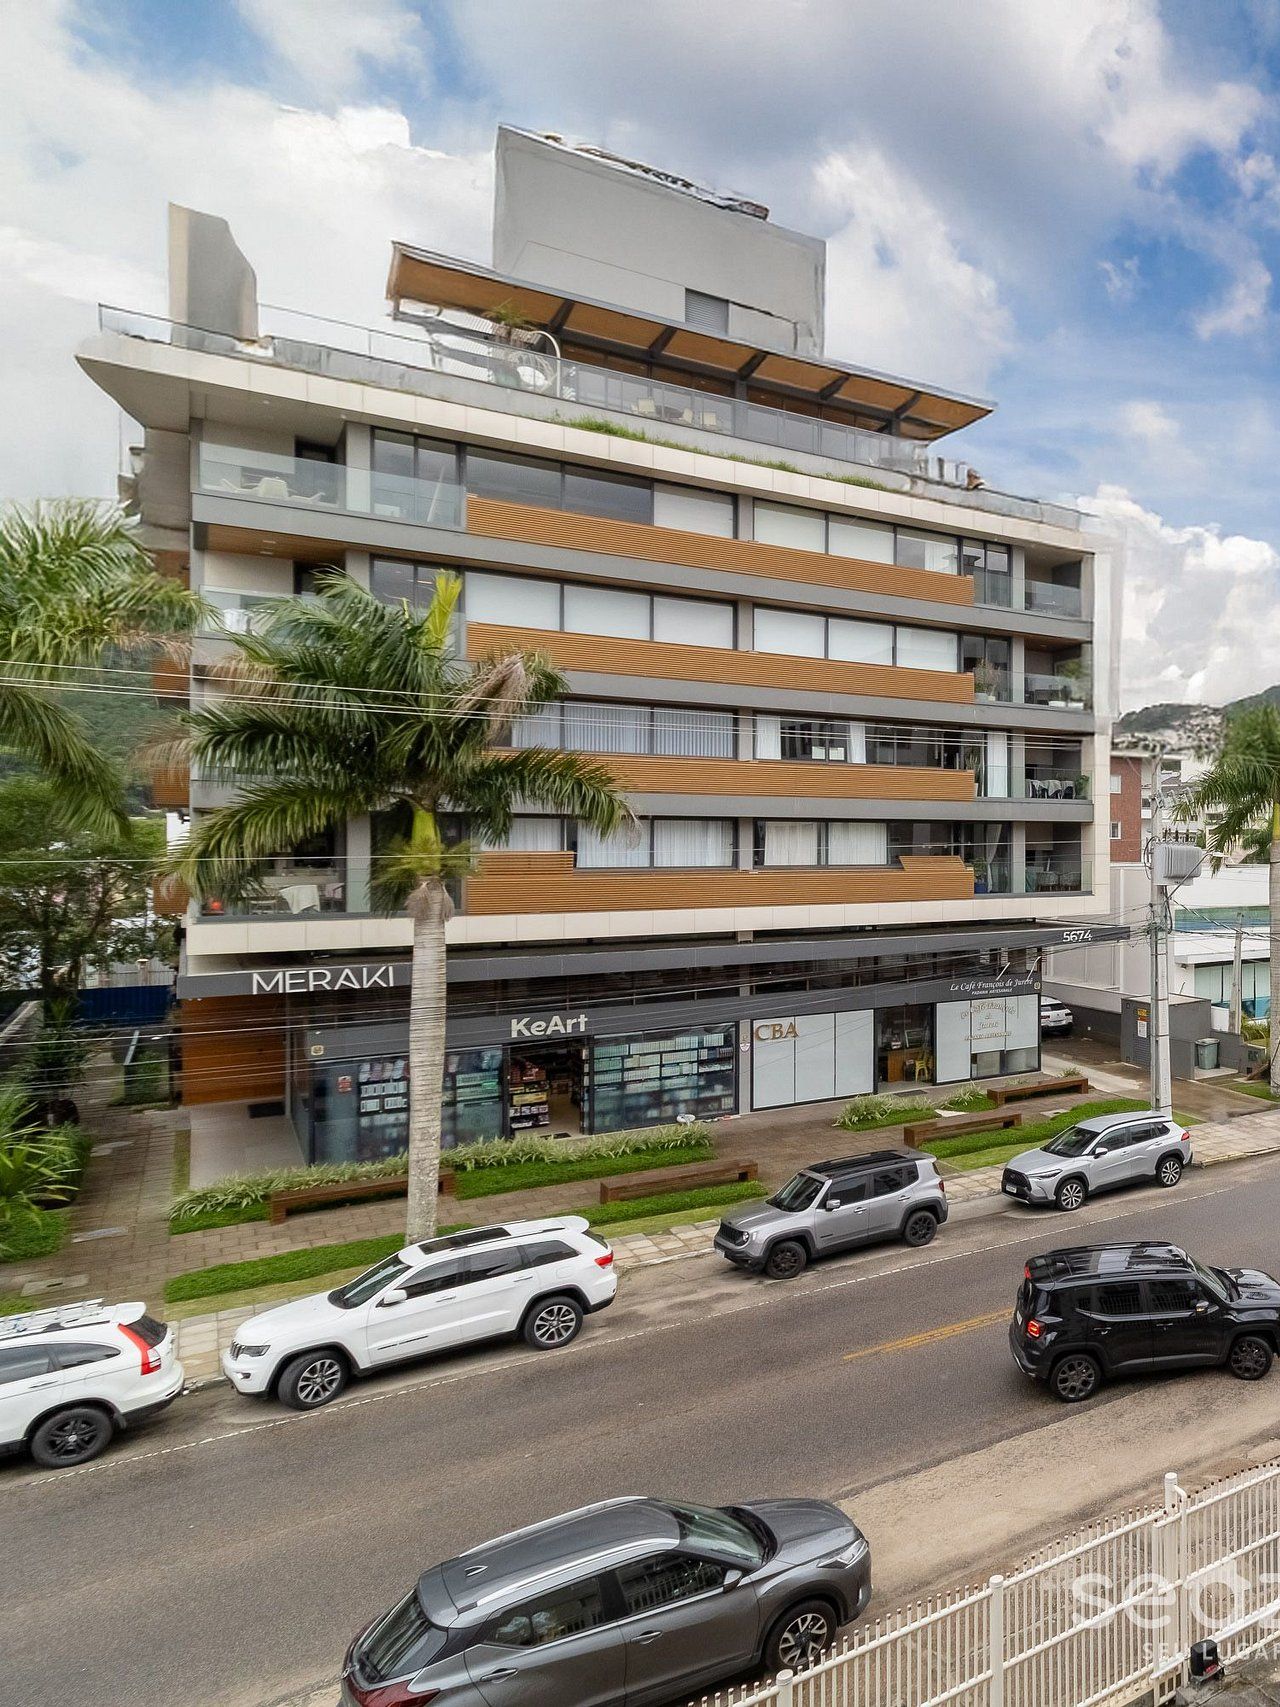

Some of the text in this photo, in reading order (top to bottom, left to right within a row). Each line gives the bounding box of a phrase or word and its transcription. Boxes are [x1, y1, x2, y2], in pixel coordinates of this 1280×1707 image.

[1062, 930, 1093, 942] 5674
[252, 965, 395, 995] MERAKI
[950, 983, 959, 991] Le
[960, 981, 975, 992] Café
[977, 980, 1005, 989] François
[1005, 978, 1013, 987] de
[511, 1014, 588, 1038] KeArt
[754, 1021, 799, 1041] CBA
